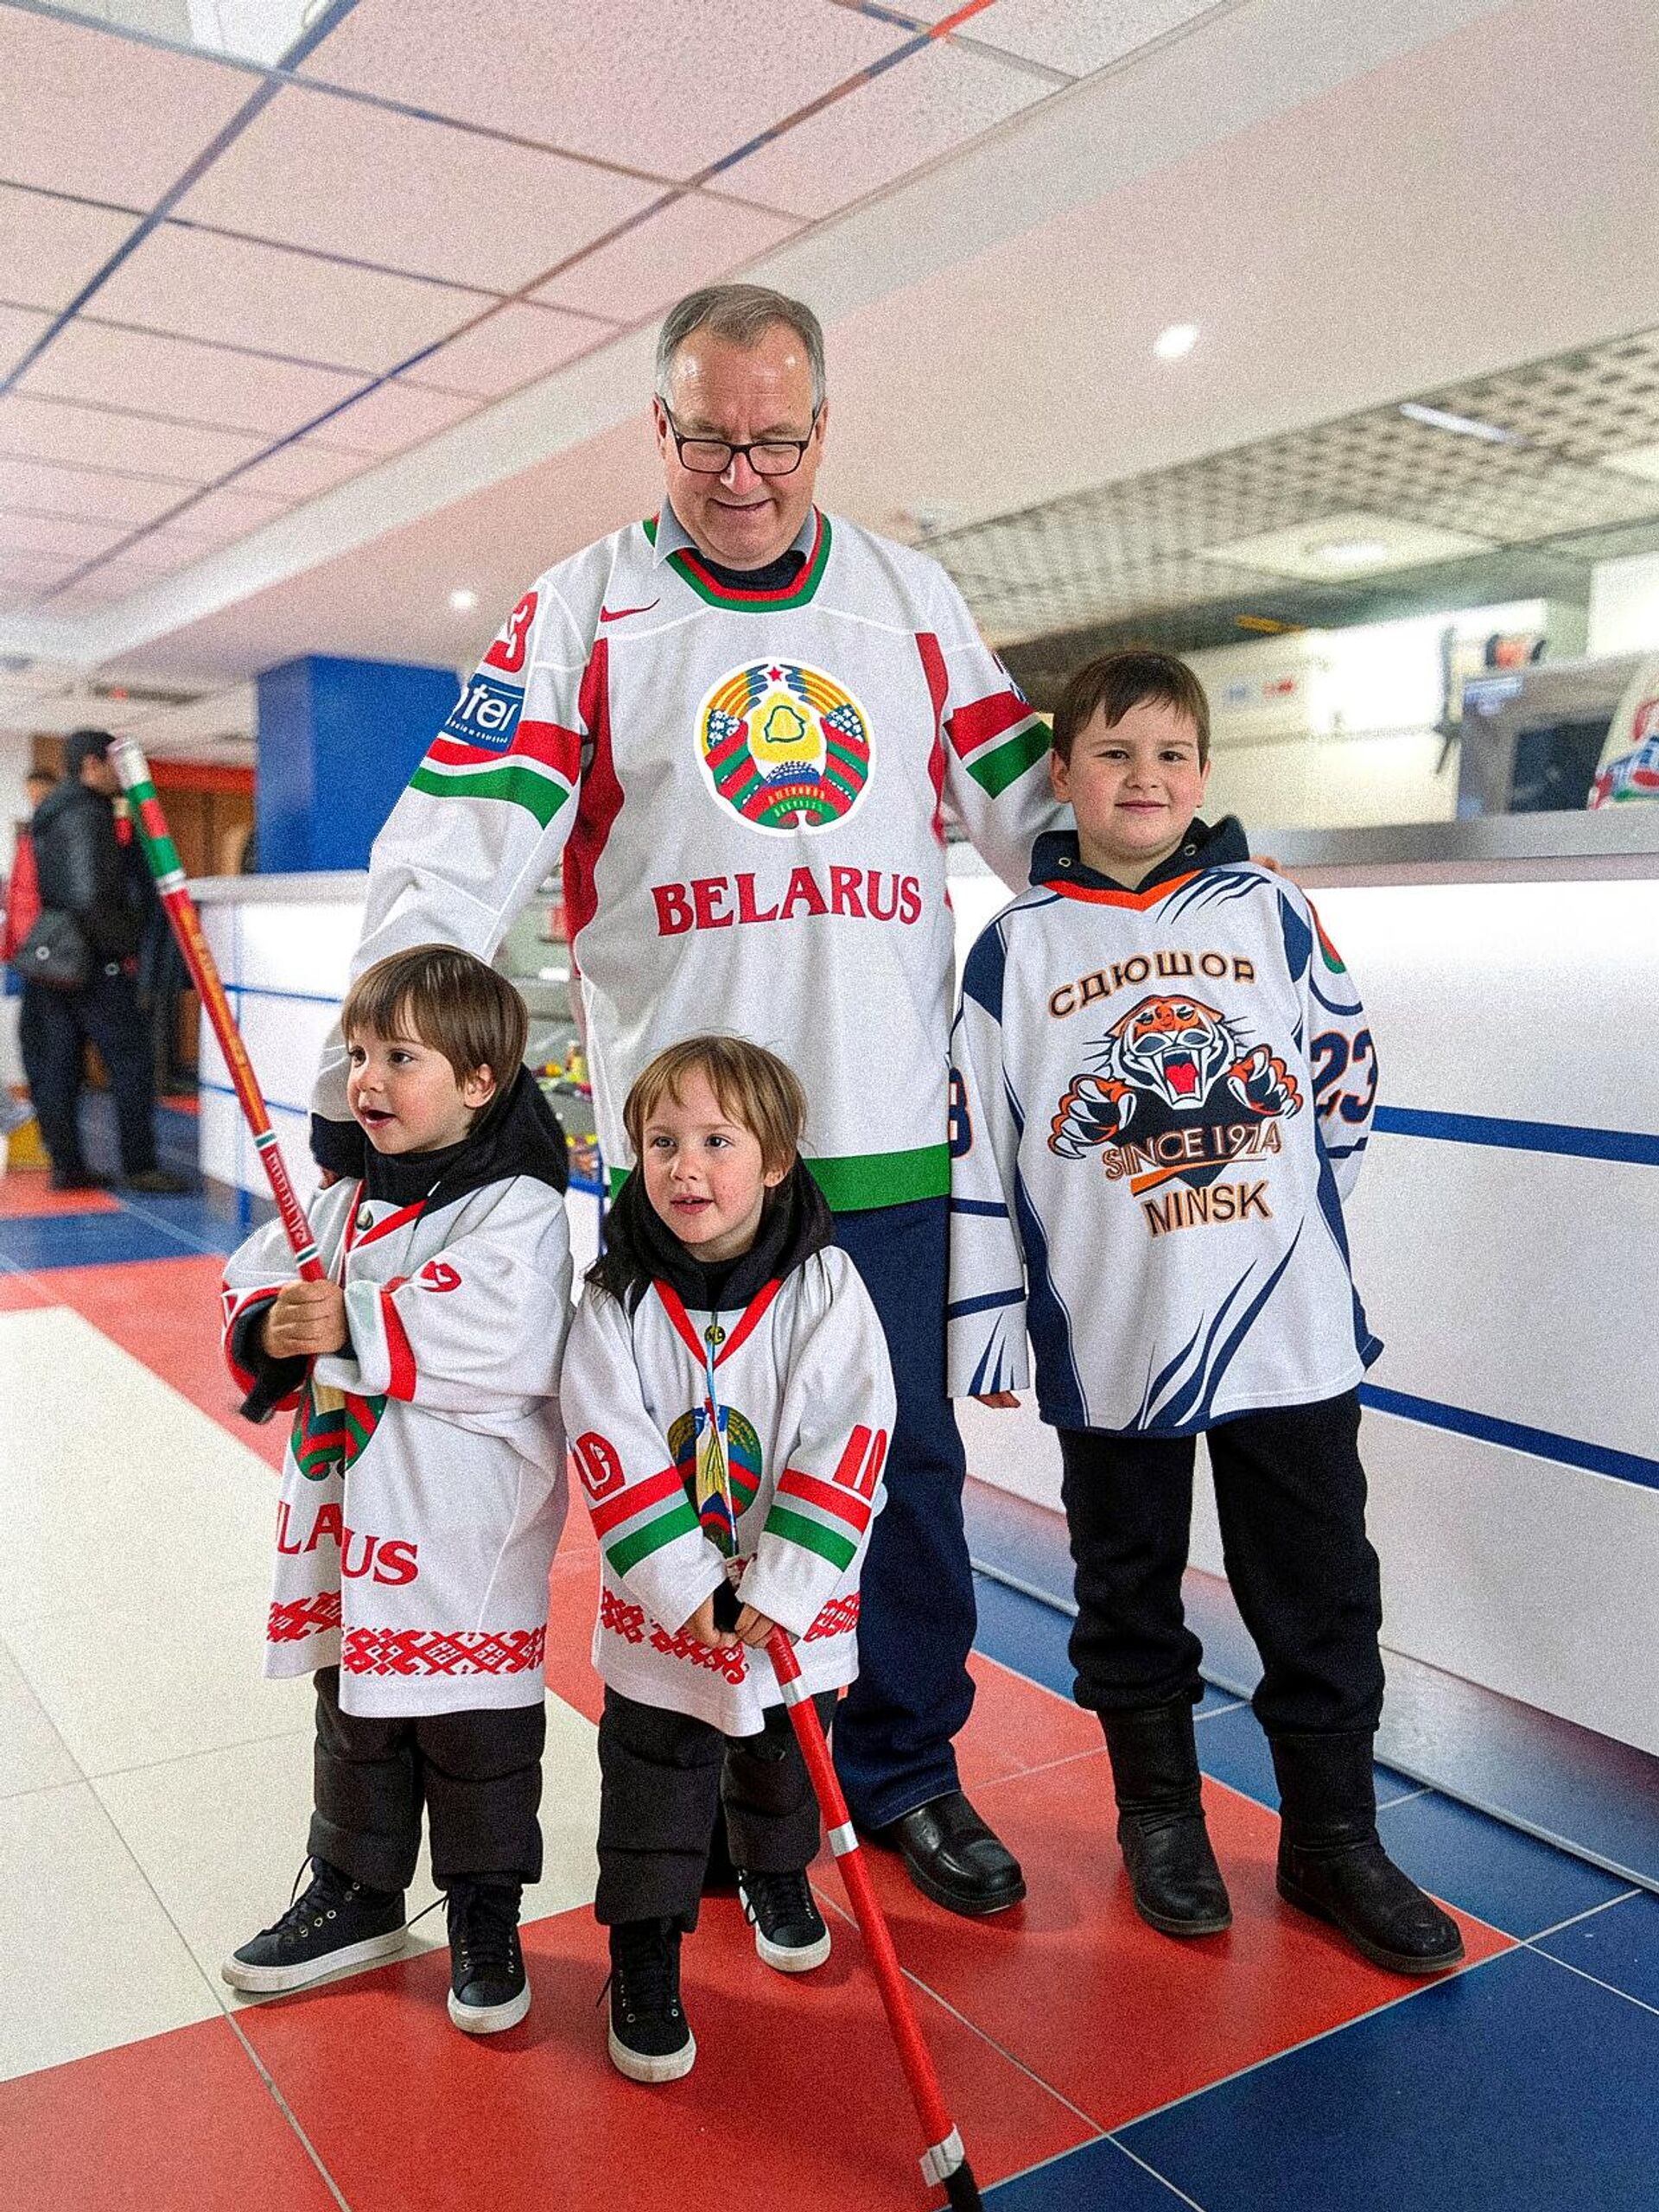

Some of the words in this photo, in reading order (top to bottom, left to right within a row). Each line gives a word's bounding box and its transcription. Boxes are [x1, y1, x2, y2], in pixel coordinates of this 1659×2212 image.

[447, 683, 518, 732] tel
[650, 865, 923, 937] BELARUS
[1309, 1027, 1379, 1123] 23
[1102, 1127, 1205, 1181] SINCE
